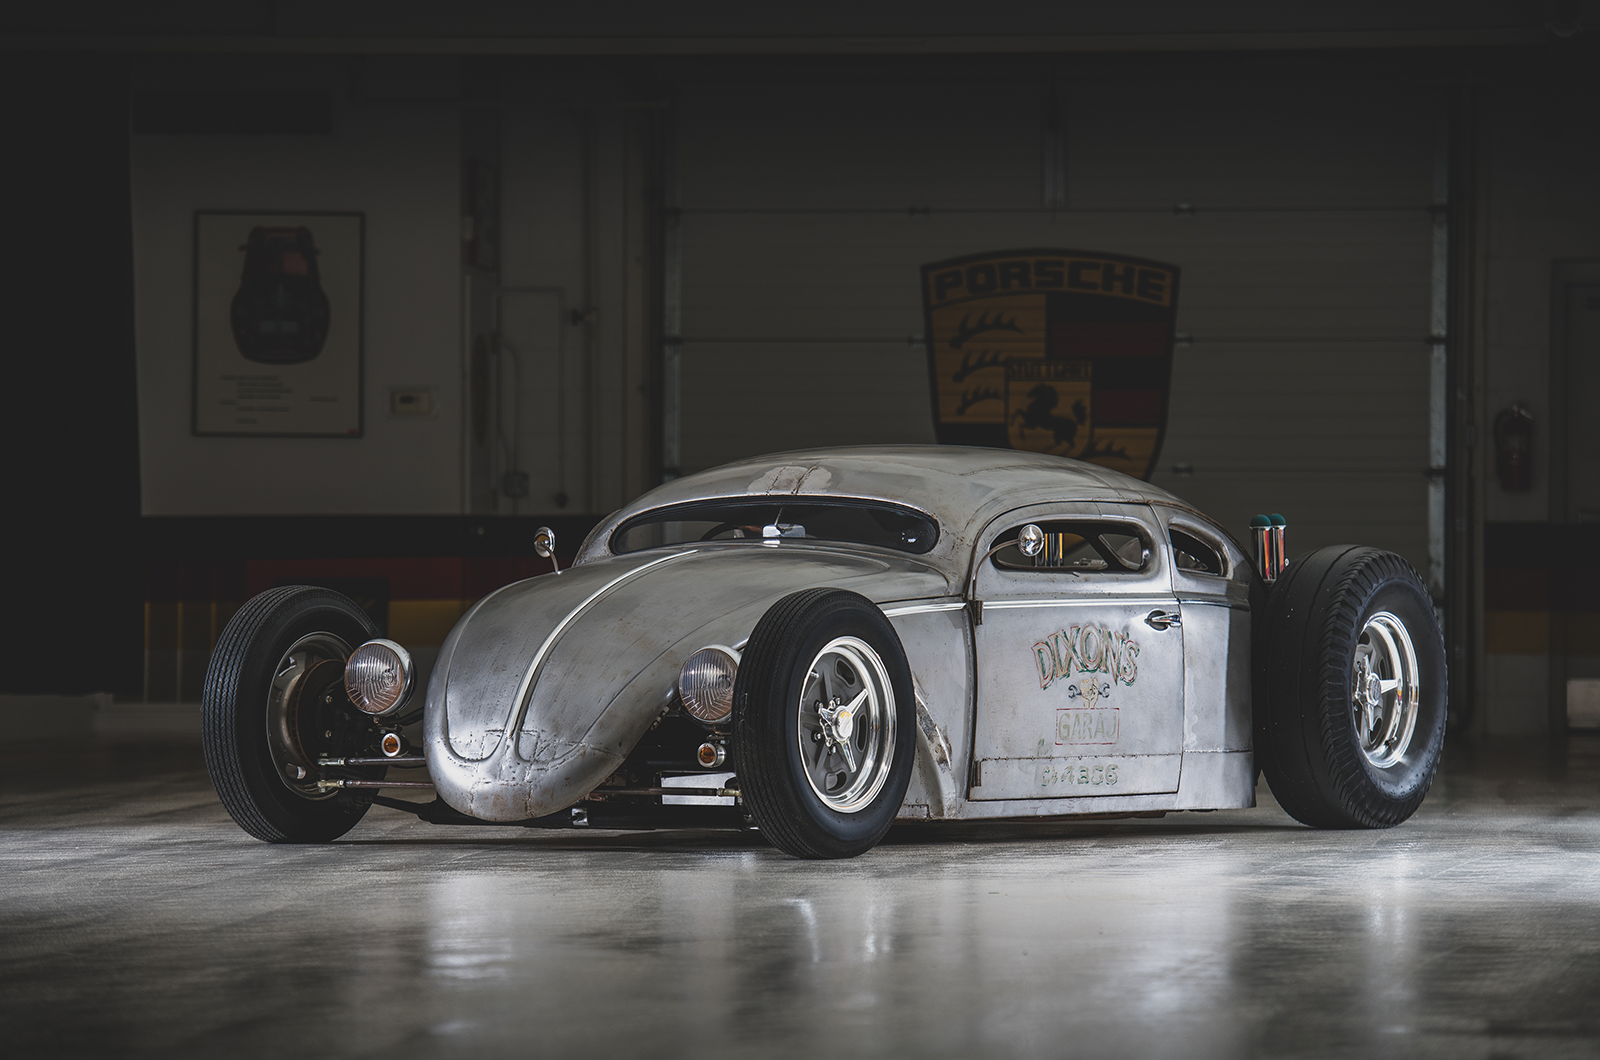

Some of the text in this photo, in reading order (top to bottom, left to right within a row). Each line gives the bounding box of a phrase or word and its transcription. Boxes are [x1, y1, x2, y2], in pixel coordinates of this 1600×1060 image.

[934, 260, 1167, 302] PORSCHE
[1031, 624, 1140, 690] DIXON'S
[1058, 712, 1118, 742] GARAJ
